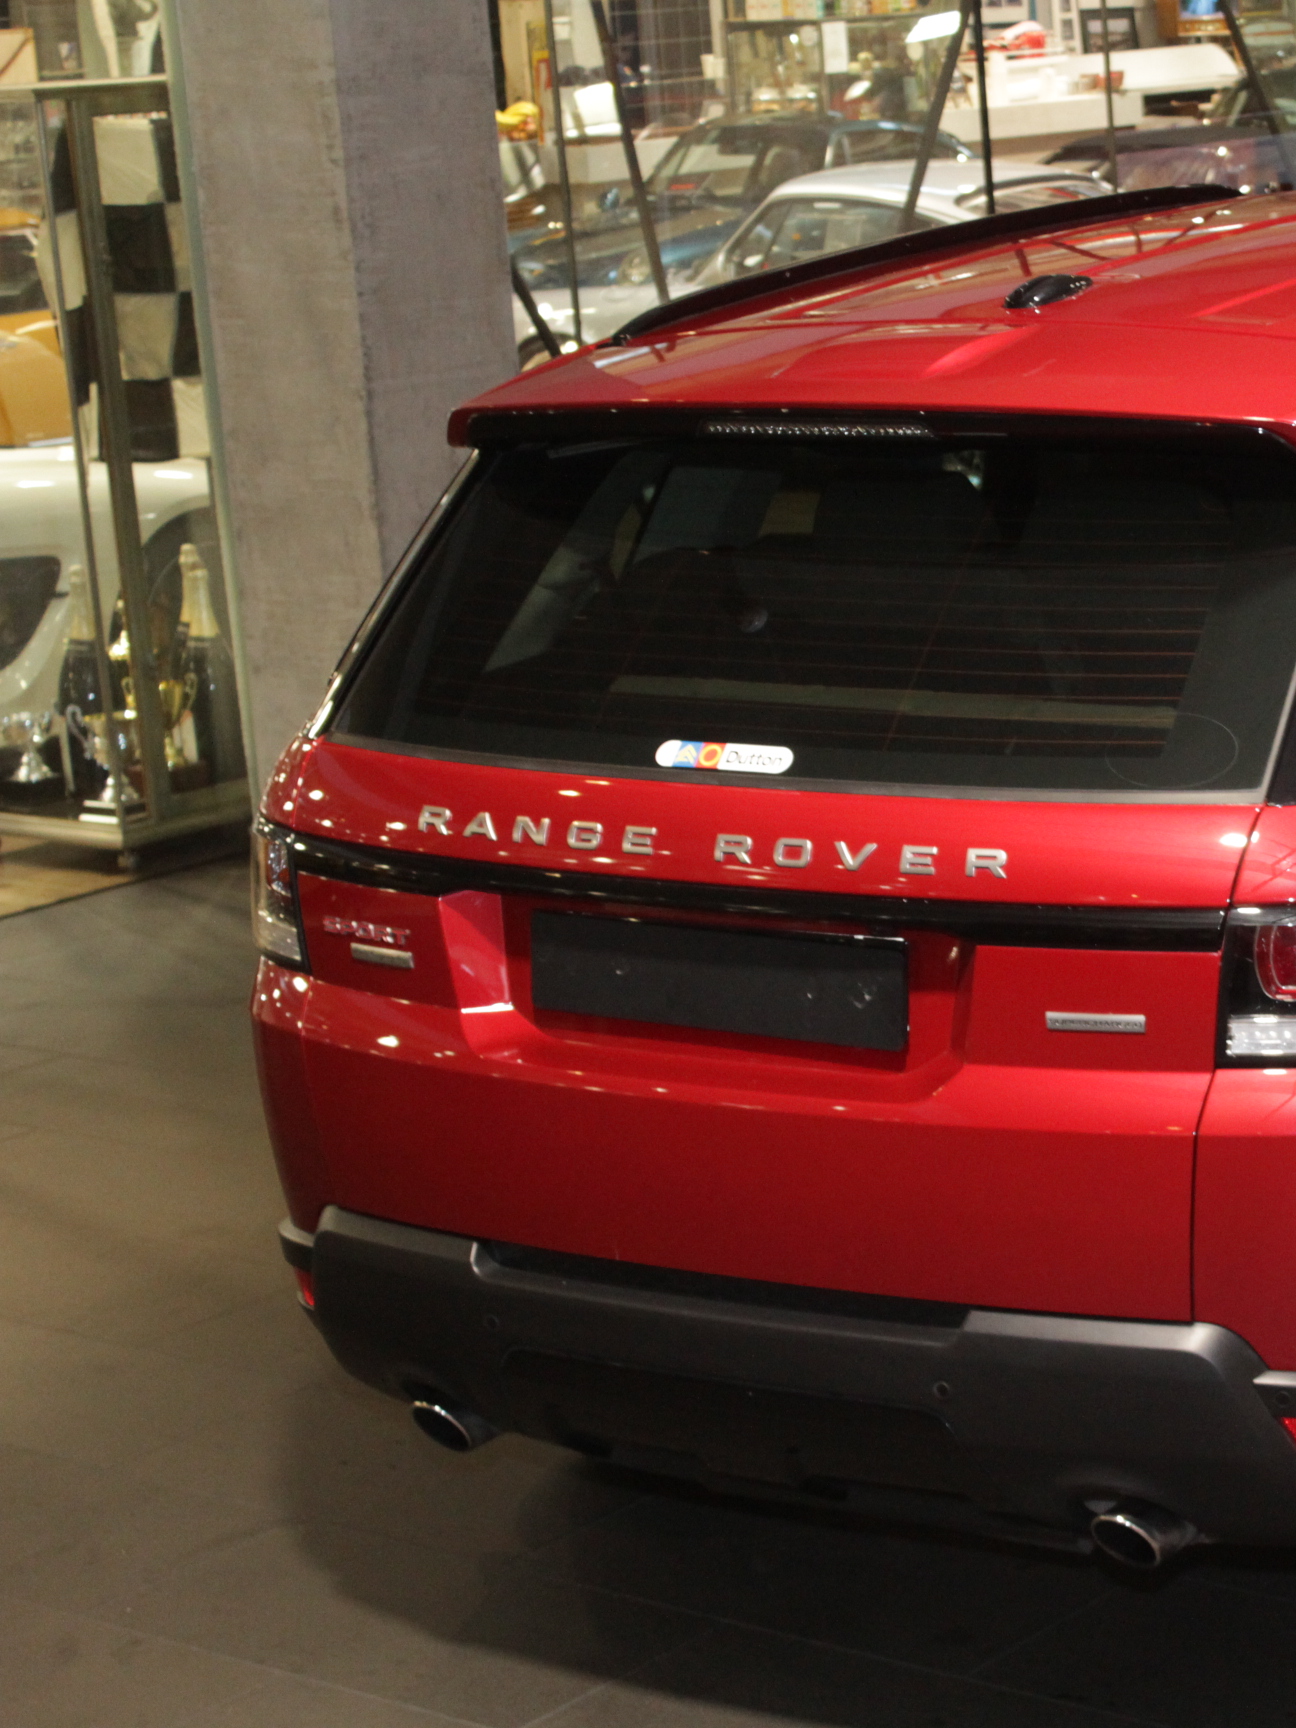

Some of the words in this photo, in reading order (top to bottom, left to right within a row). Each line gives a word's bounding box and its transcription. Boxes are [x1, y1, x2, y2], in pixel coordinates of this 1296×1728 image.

[725, 750, 783, 766] Dutton
[418, 805, 657, 855] RANGE
[713, 833, 1007, 879] ROVER
